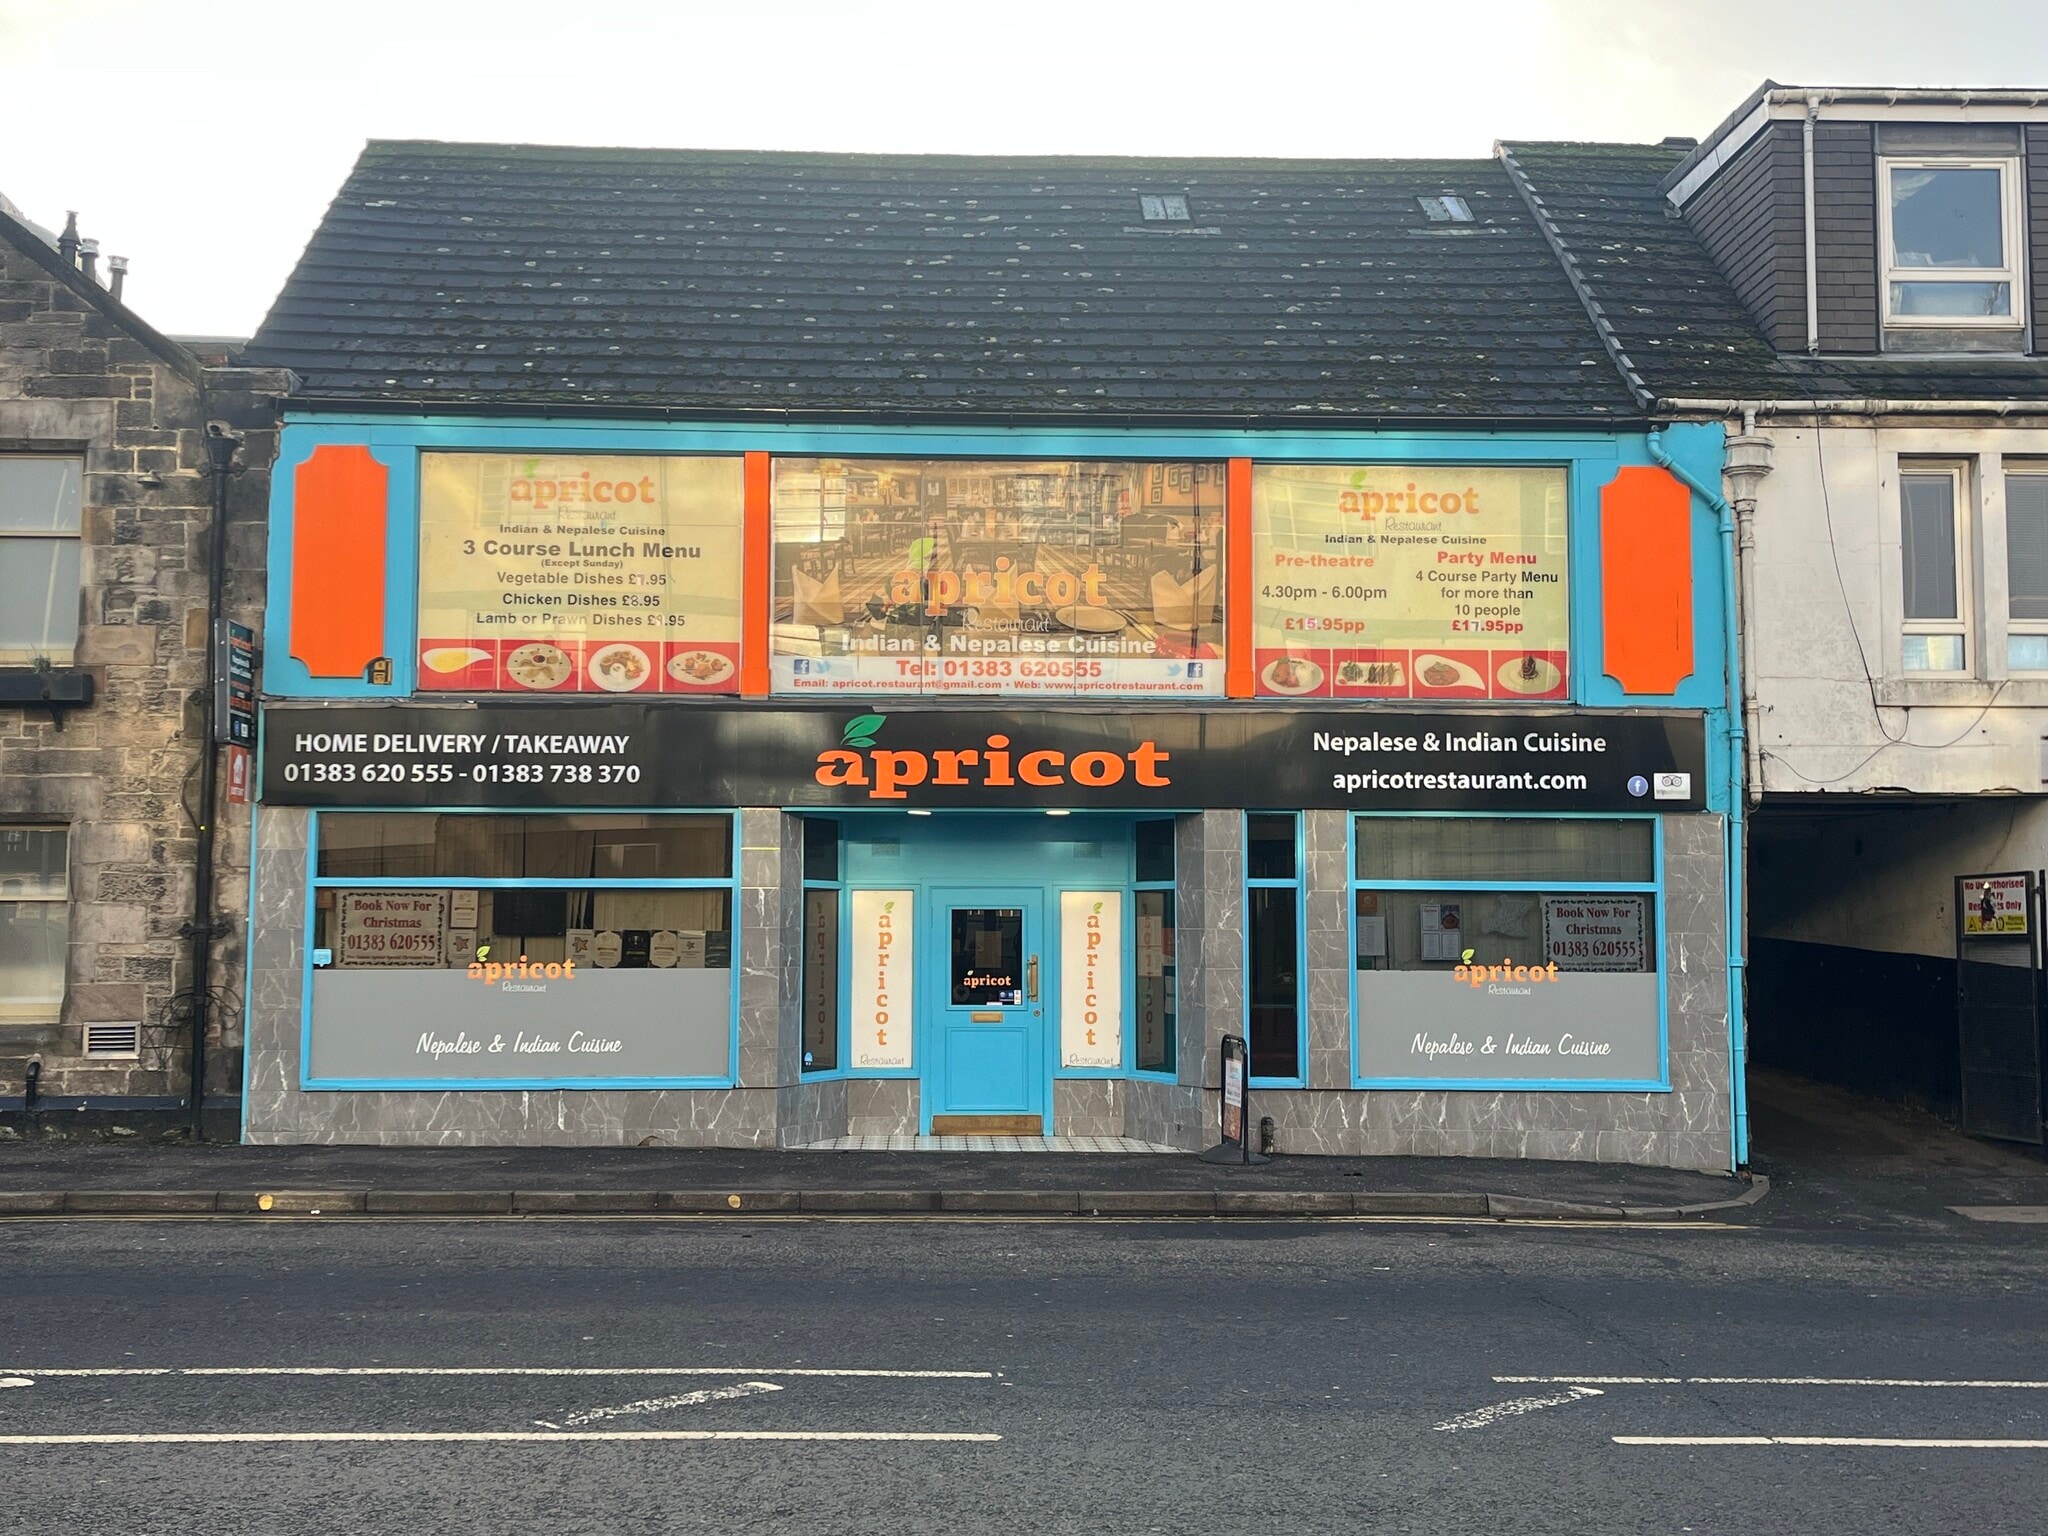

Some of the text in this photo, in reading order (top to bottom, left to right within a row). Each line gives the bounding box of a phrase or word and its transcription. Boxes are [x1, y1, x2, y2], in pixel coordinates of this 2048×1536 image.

[511, 471, 655, 509] apricot
[1339, 483, 1479, 521] apricot
[558, 505, 616, 520] Restaurant
[500, 525, 666, 537] Indian & Nepalese Cuisine
[1385, 517, 1442, 532] Restaurant
[1325, 534, 1487, 546] Indian & Nepalese Cuisine
[463, 540, 701, 558] 3 Course Lunch Menu
[541, 559, 623, 569] (Except Sunday)
[1275, 554, 1374, 568] Pre-theatre
[1437, 551, 1537, 567] Party Menu
[497, 572, 568, 587] Vegetable
[574, 572, 623, 586] Dishes
[1416, 570, 1558, 586] 4 Course Party Menu
[891, 557, 1108, 616] apricot
[1262, 585, 1317, 601] 4.30pm
[1332, 586, 1387, 601] 6.00pm
[1441, 587, 1534, 599] for more than
[502, 593, 660, 607] Chicken Dishes £8.95
[476, 612, 516, 625] Lamb
[522, 615, 537, 625] or
[542, 613, 587, 625] Prawn
[592, 613, 642, 626] Dishes
[1455, 604, 1521, 619] 10 people
[962, 609, 1051, 632] Restaurant
[1285, 617, 1365, 634] £15.95pp
[1452, 619, 1524, 635] £17.95pp
[842, 634, 1156, 657] Indian & Nepalese Cuisine
[896, 660, 1102, 677] Tel: 01383 620555
[794, 679, 1203, 690] Email: apricot.restaurant@gmail.com Web: www.apricotrestaurant.com
[295, 733, 630, 755] HOME DELIVERY / TAKEAWAY
[1313, 732, 1607, 755] Nepalese & Indian Cuisine
[284, 763, 356, 783] 01383
[362, 763, 405, 783] 620
[411, 763, 454, 783] 555
[472, 763, 544, 783] 01383
[550, 764, 593, 783] 738
[598, 764, 641, 784] 370
[815, 734, 1172, 799] apricot
[1333, 770, 1587, 794] apricotrestaurant.com
[1965, 882, 1974, 890] No
[354, 899, 432, 912] Book Now For
[1556, 907, 1631, 918] Book Now For
[2006, 901, 2022, 911] Only
[364, 916, 422, 928] Christmas
[1566, 923, 1622, 935] Christmas
[348, 933, 435, 951] 01383 620555
[1553, 939, 1636, 957] 01383 620555
[467, 955, 576, 985] apricot
[1454, 958, 1559, 988] apricot
[502, 982, 547, 992] Restaurant
[875, 914, 893, 1045] apricot
[963, 974, 1011, 988] apricot
[1084, 914, 1101, 1045] apricot
[1488, 984, 1531, 995] Restaurant
[415, 1031, 622, 1060] Nepalese & Indian Cuisine
[1411, 1033, 1611, 1061] Nepalese & Indian Cuisine
[860, 1054, 905, 1066] Restaurant
[1069, 1053, 1114, 1066] Restaurant
